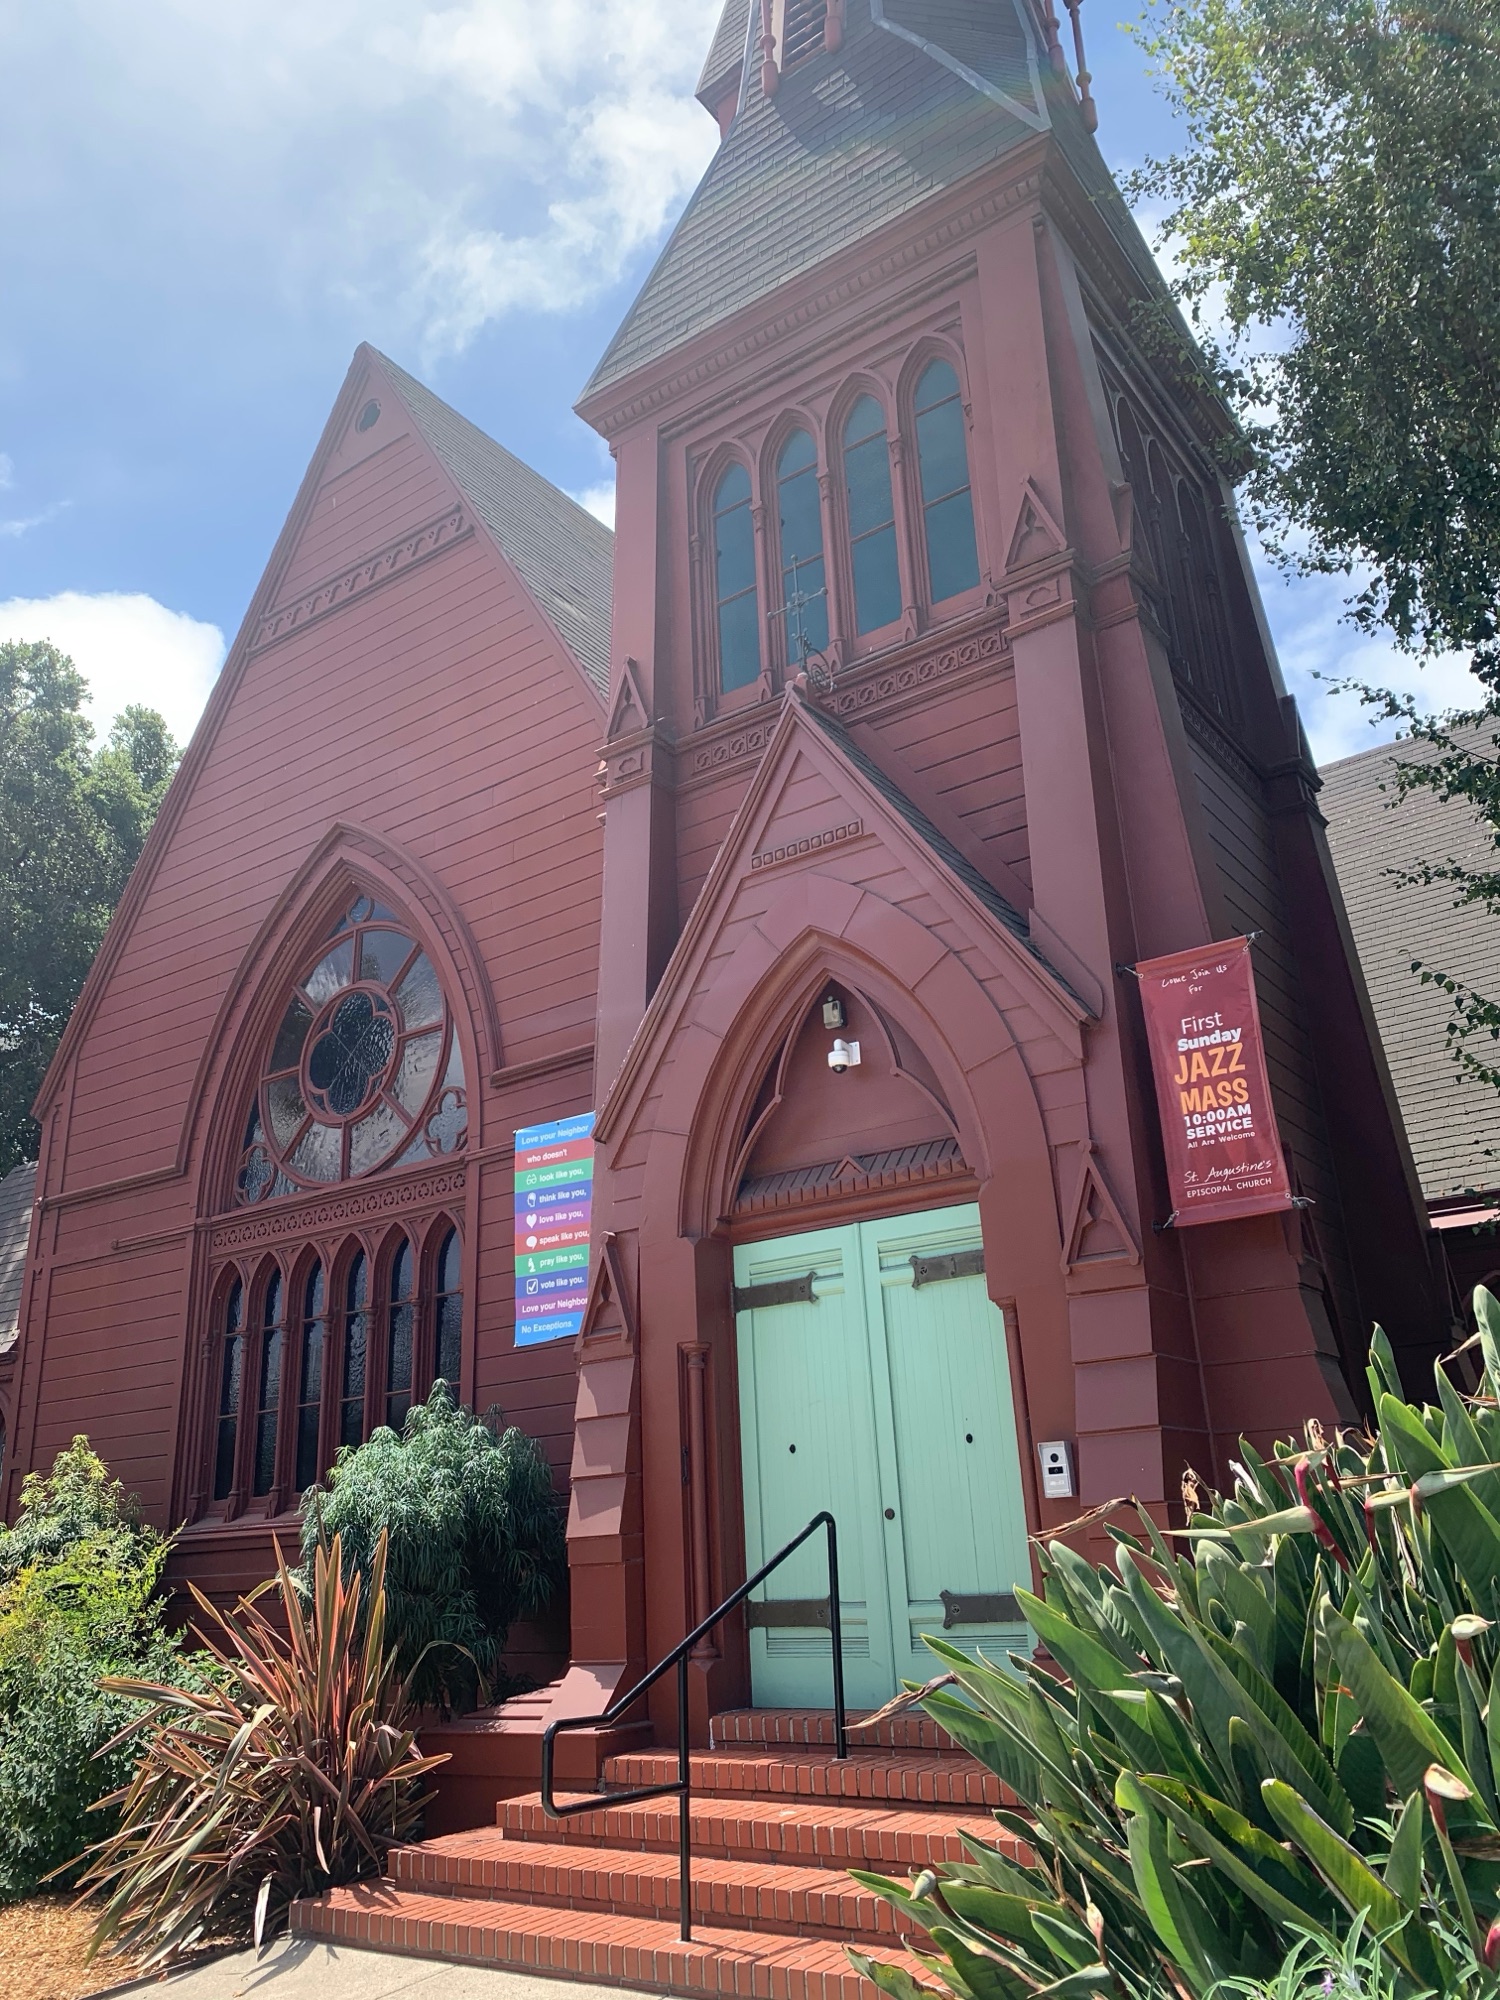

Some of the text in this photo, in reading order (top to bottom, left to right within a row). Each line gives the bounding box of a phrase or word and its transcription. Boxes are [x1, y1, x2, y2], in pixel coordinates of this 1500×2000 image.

[1190, 968, 1210, 980] Join
[1216, 964, 1228, 974] Us
[1188, 984, 1203, 994] For
[1181, 1012, 1224, 1034] First
[1178, 1026, 1242, 1052] Sunday
[1174, 1042, 1246, 1084] JAZZ
[1180, 1080, 1249, 1114] MASS
[1184, 1104, 1252, 1126] 10:00AM
[540, 1132, 556, 1142] your
[558, 1125, 588, 1137] Neighbor
[1186, 1116, 1253, 1140] SERVICE
[1188, 1131, 1256, 1149] All Are Welcome
[527, 1149, 567, 1163] who doesn't
[540, 1173, 554, 1182] look
[569, 1168, 583, 1178] you,
[1184, 1160, 1272, 1183] St. Augustine's
[539, 1194, 556, 1203] think
[571, 1189, 586, 1199] you,
[1186, 1178, 1272, 1198] EPISCOPAL CHURCH
[539, 1215, 553, 1223] love
[568, 1211, 583, 1220] you,
[539, 1230, 589, 1245] speak like you,
[540, 1254, 584, 1268] pray like you,
[541, 1281, 555, 1289] vote
[569, 1277, 584, 1286] you.
[540, 1302, 556, 1312] your
[558, 1298, 588, 1308] Neighbor
[522, 1320, 573, 1333] No Exceptions.
